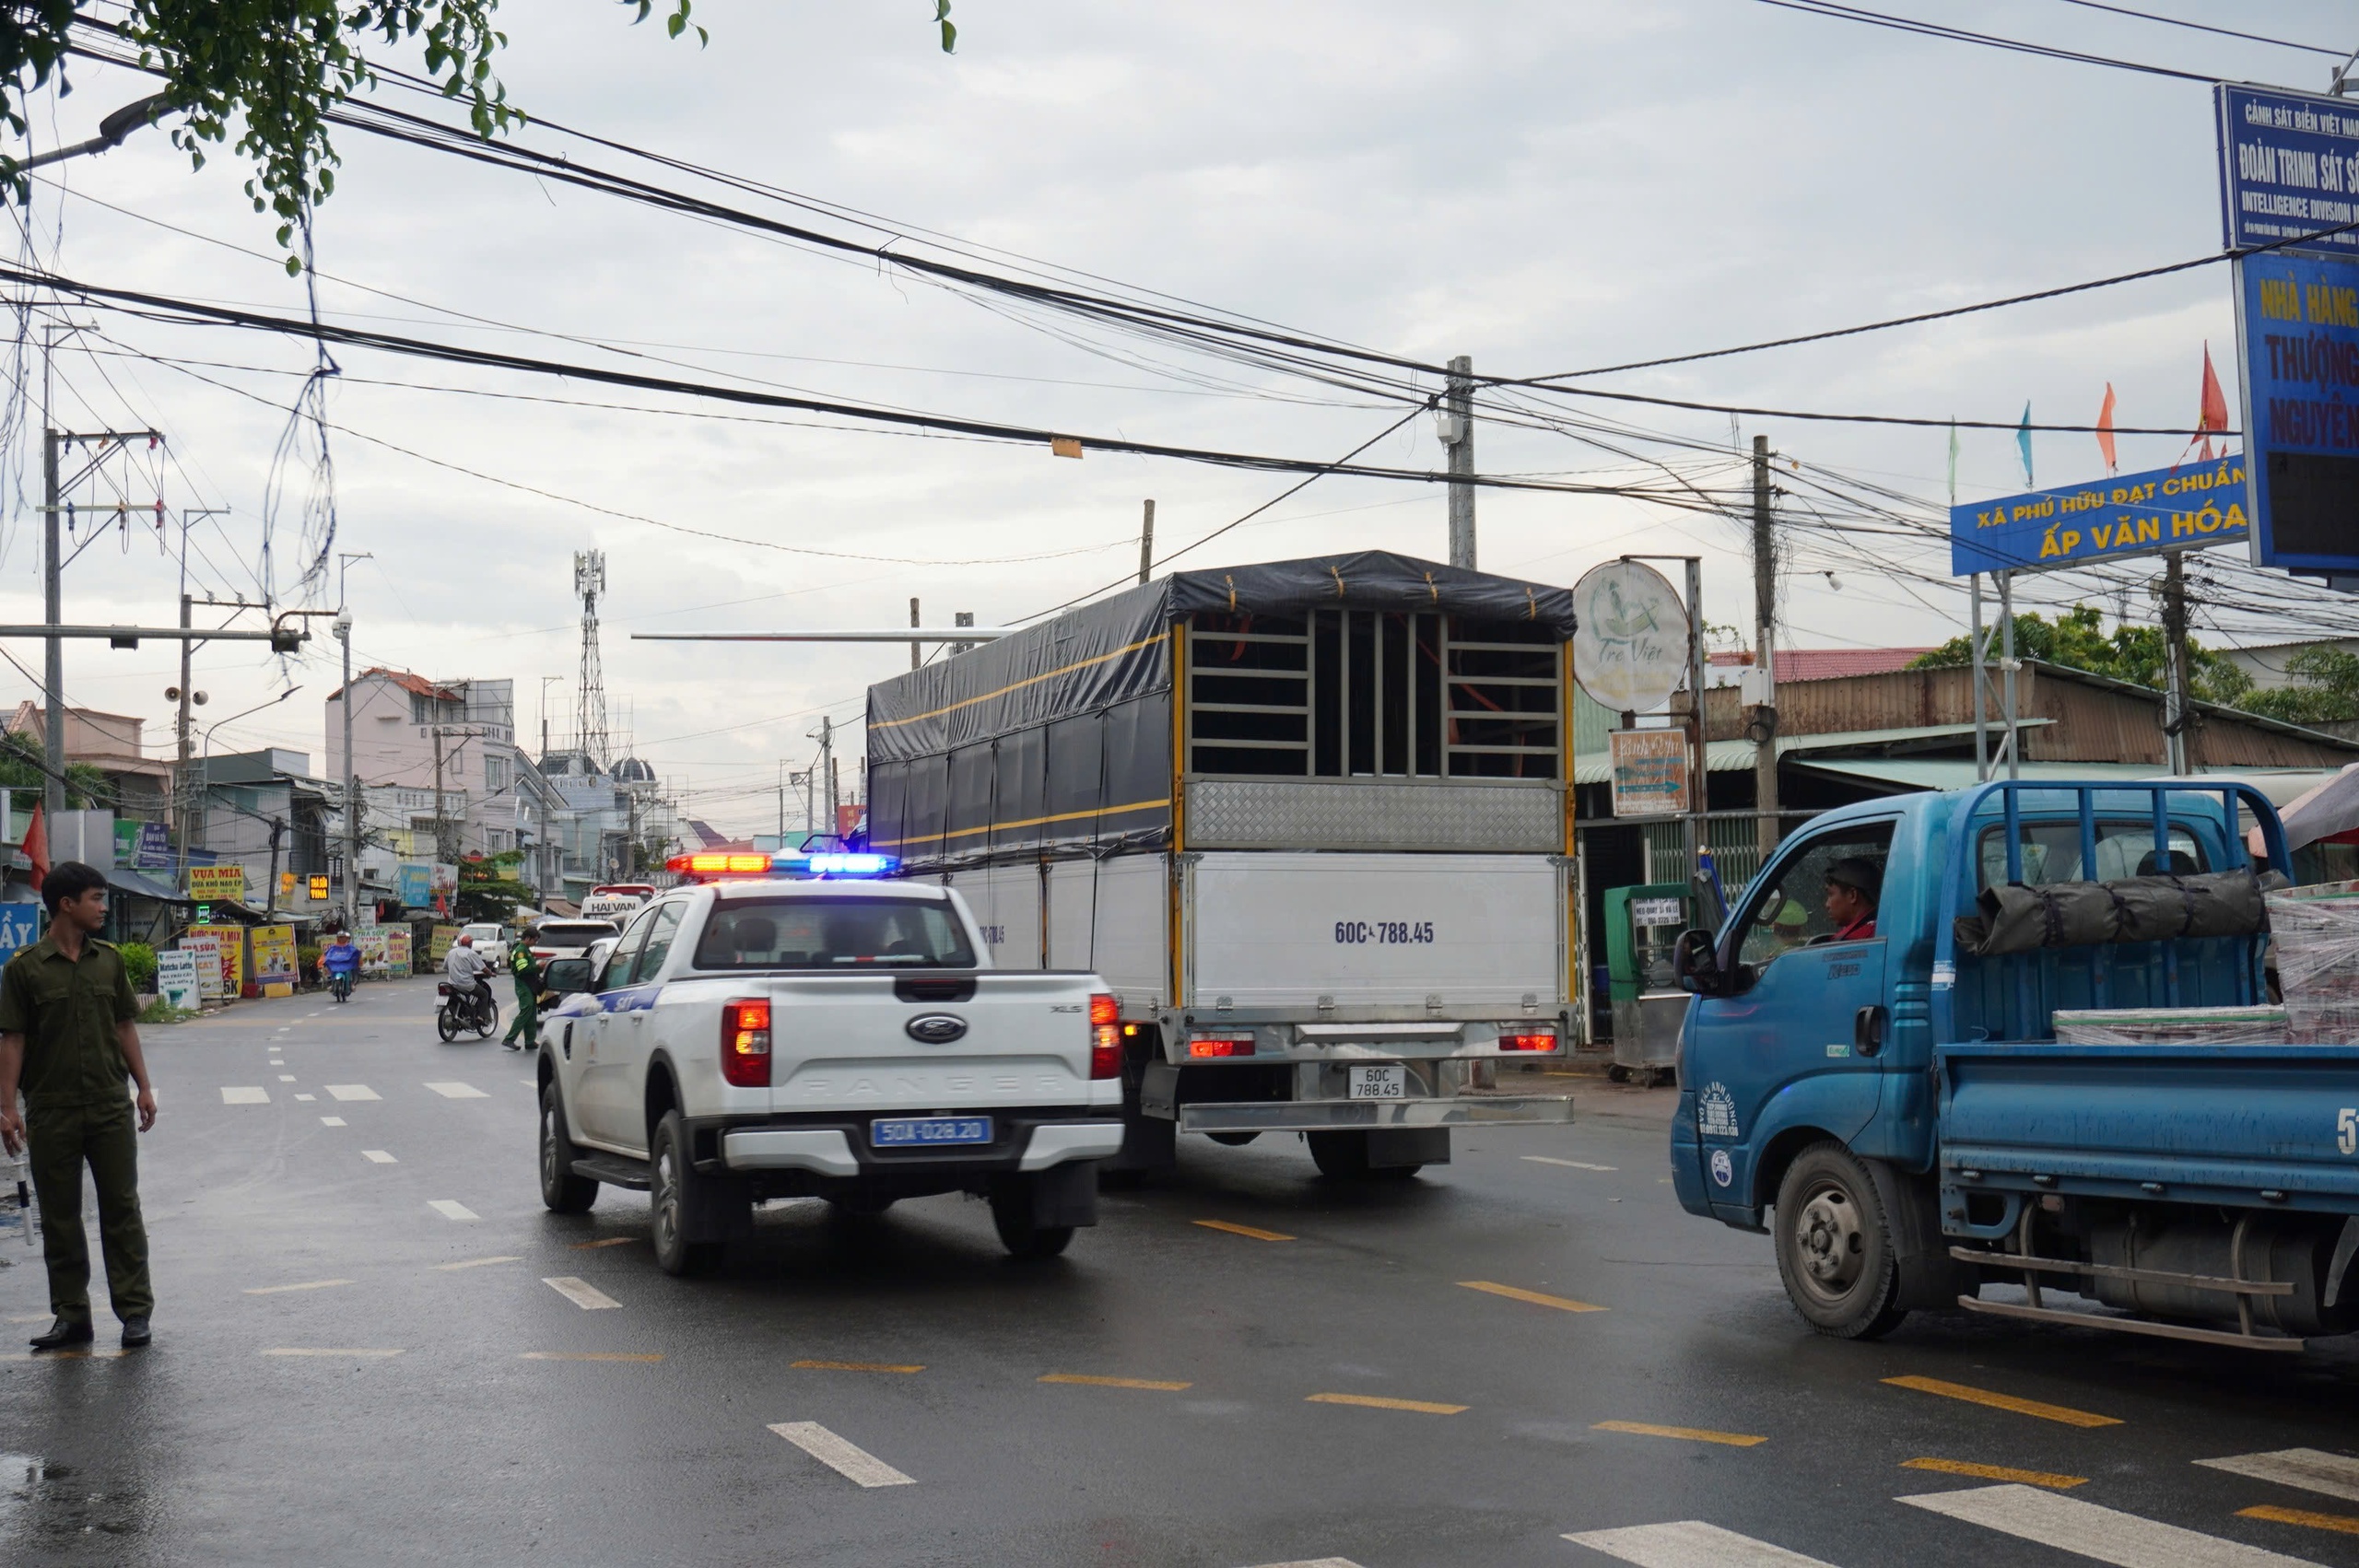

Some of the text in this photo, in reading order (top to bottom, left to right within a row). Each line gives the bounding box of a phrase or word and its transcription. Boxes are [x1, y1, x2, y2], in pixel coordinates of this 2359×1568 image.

[2246, 99, 2272, 125] CẢNH
[2274, 105, 2293, 127] SÁT
[2294, 103, 2318, 132] BIỂN
[2320, 112, 2341, 137] VIỆT
[2239, 137, 2276, 184] ĐOÀN
[2278, 148, 2318, 189] TRINH
[2320, 148, 2343, 193] SÁT
[2242, 190, 2308, 219] INTELLIGENCE
[2310, 199, 2352, 223] DIVISION
[2260, 270, 2301, 322] NHÀ
[2265, 330, 2359, 393] THƯỢNG
[1977, 461, 2246, 530] XÃ PHÚ HỮU ĐẠT CHUẨN
[2039, 498, 2248, 559] ẤP VĂN HÓA
[1631, 637, 1663, 665] Việt
[227, 930, 241, 942] MIX
[1049, 1005, 1083, 1014] XLS
[1356, 1083, 1400, 1096] 788.45
[1366, 1069, 1390, 1082] 60C
